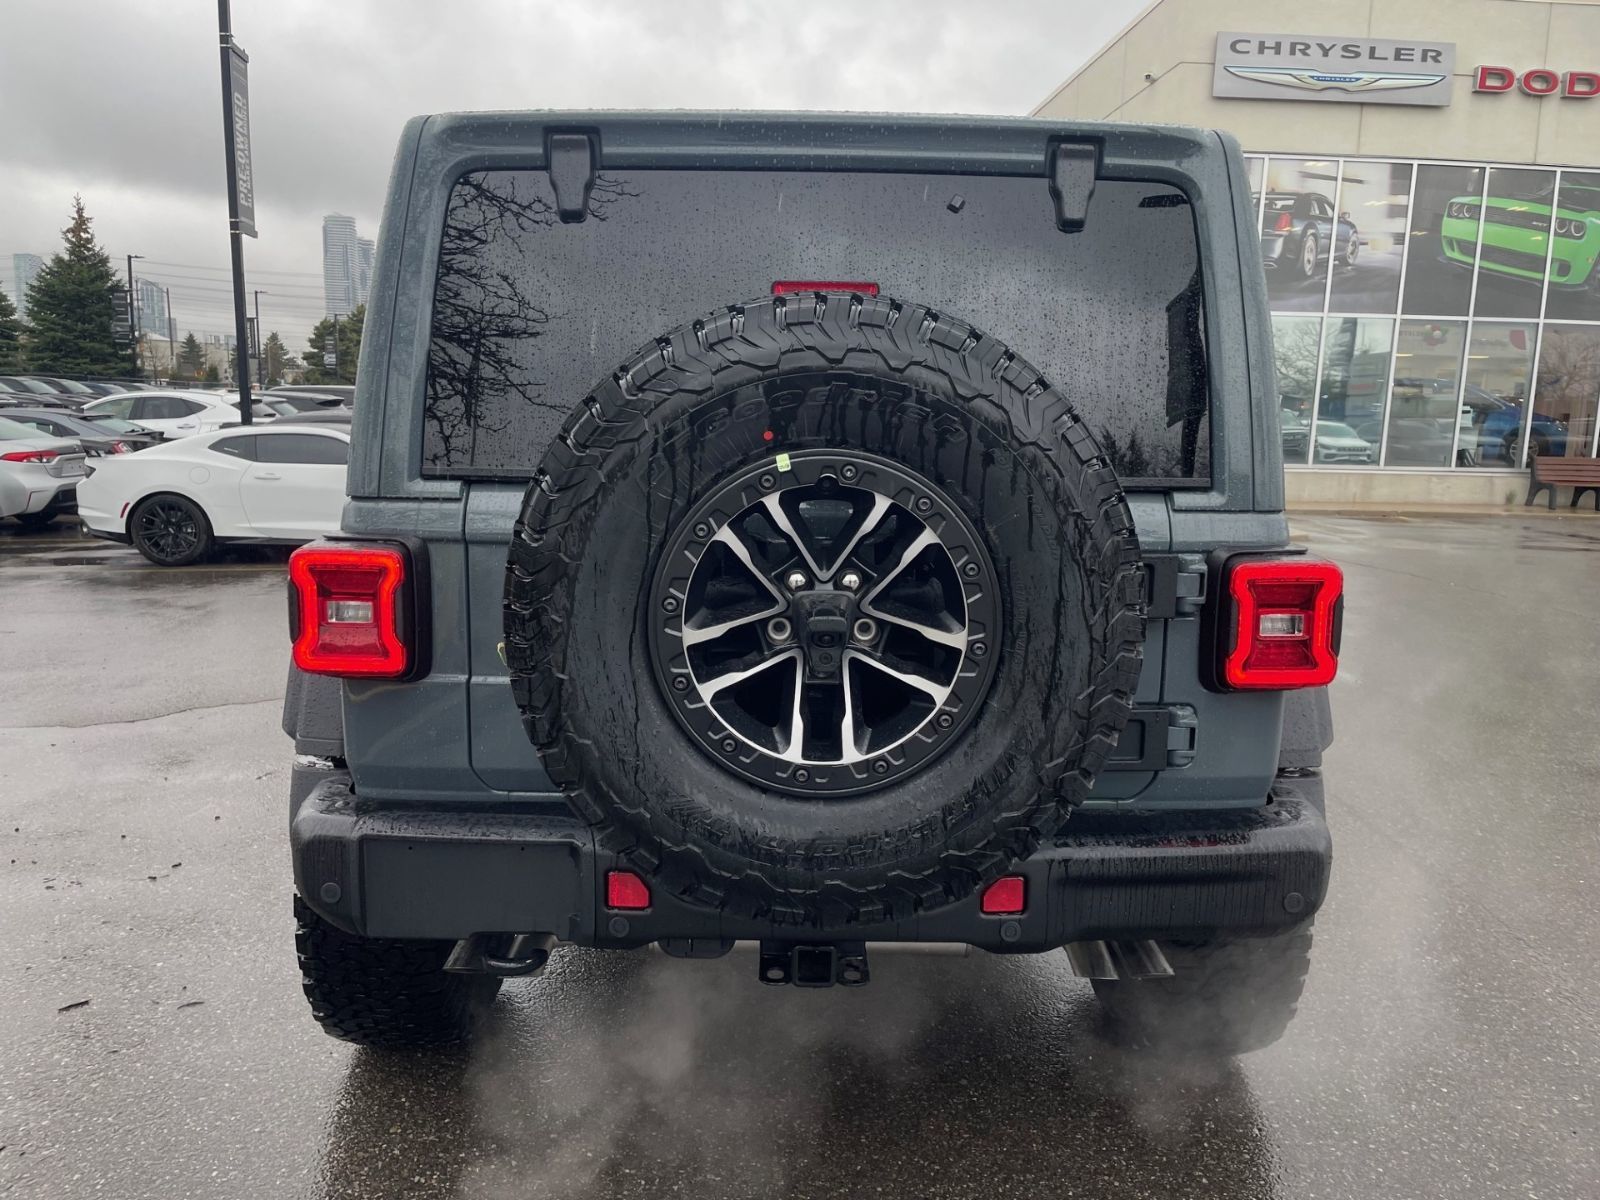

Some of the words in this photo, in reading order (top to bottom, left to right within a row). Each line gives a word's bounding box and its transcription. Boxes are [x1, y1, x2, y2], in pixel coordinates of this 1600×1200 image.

[1229, 38, 1443, 64] CHRYSLER
[1472, 64, 1600, 99] DOD
[233, 91, 248, 207] PRE-OWNED
